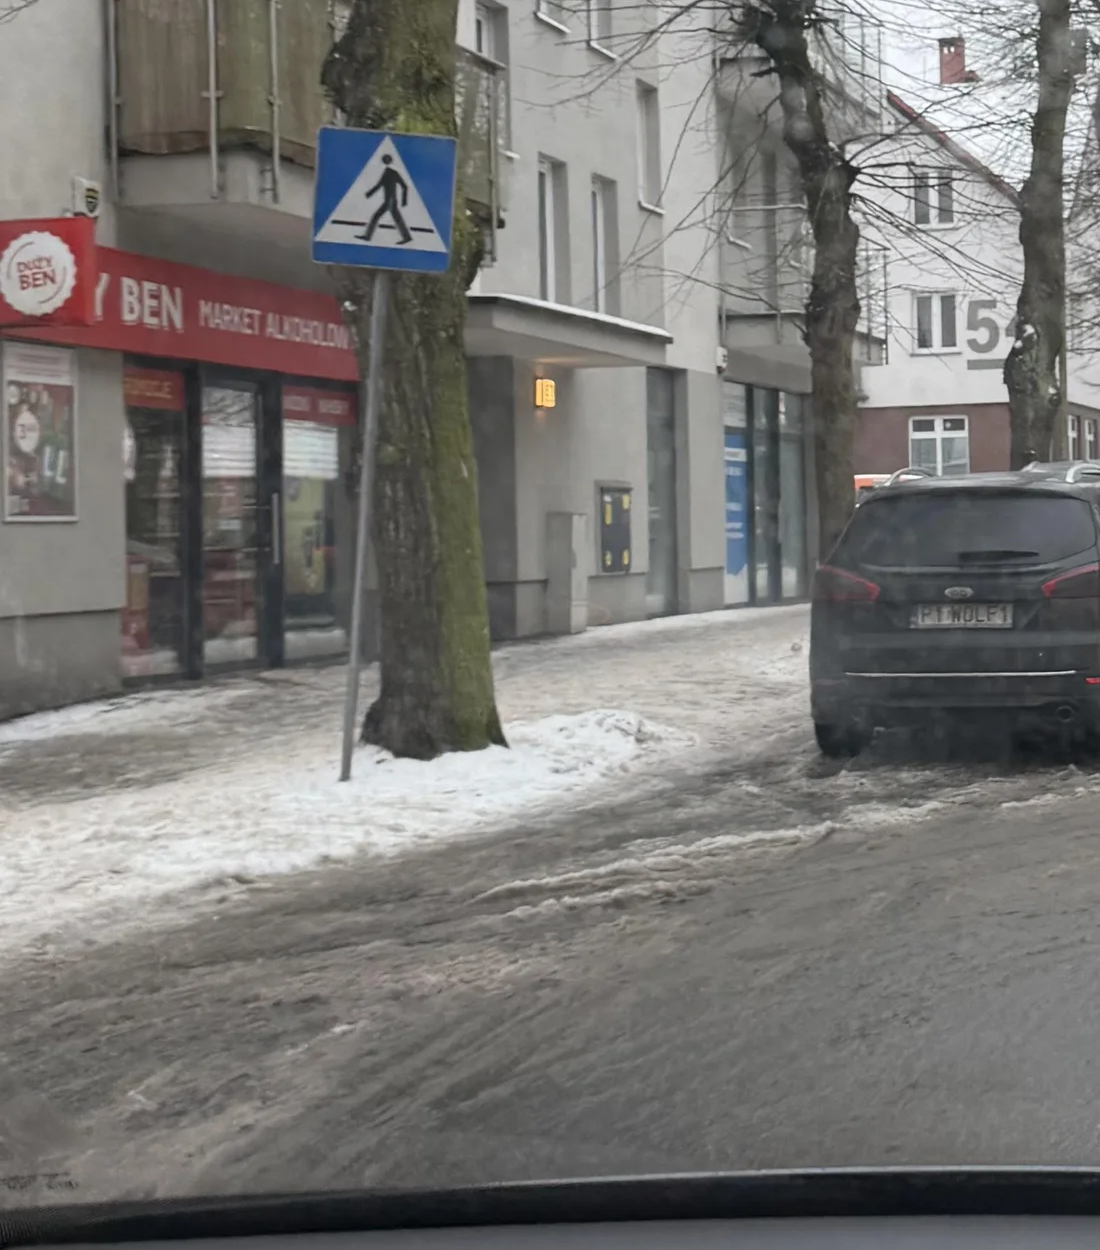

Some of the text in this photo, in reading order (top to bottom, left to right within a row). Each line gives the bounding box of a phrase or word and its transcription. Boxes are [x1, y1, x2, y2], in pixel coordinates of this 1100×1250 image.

[19, 269, 56, 290] BEN
[121, 276, 184, 334] BEN
[199, 300, 262, 335] MARKET
[265, 312, 352, 350] ALKOHOLOW
[966, 299, 1017, 354] 5
